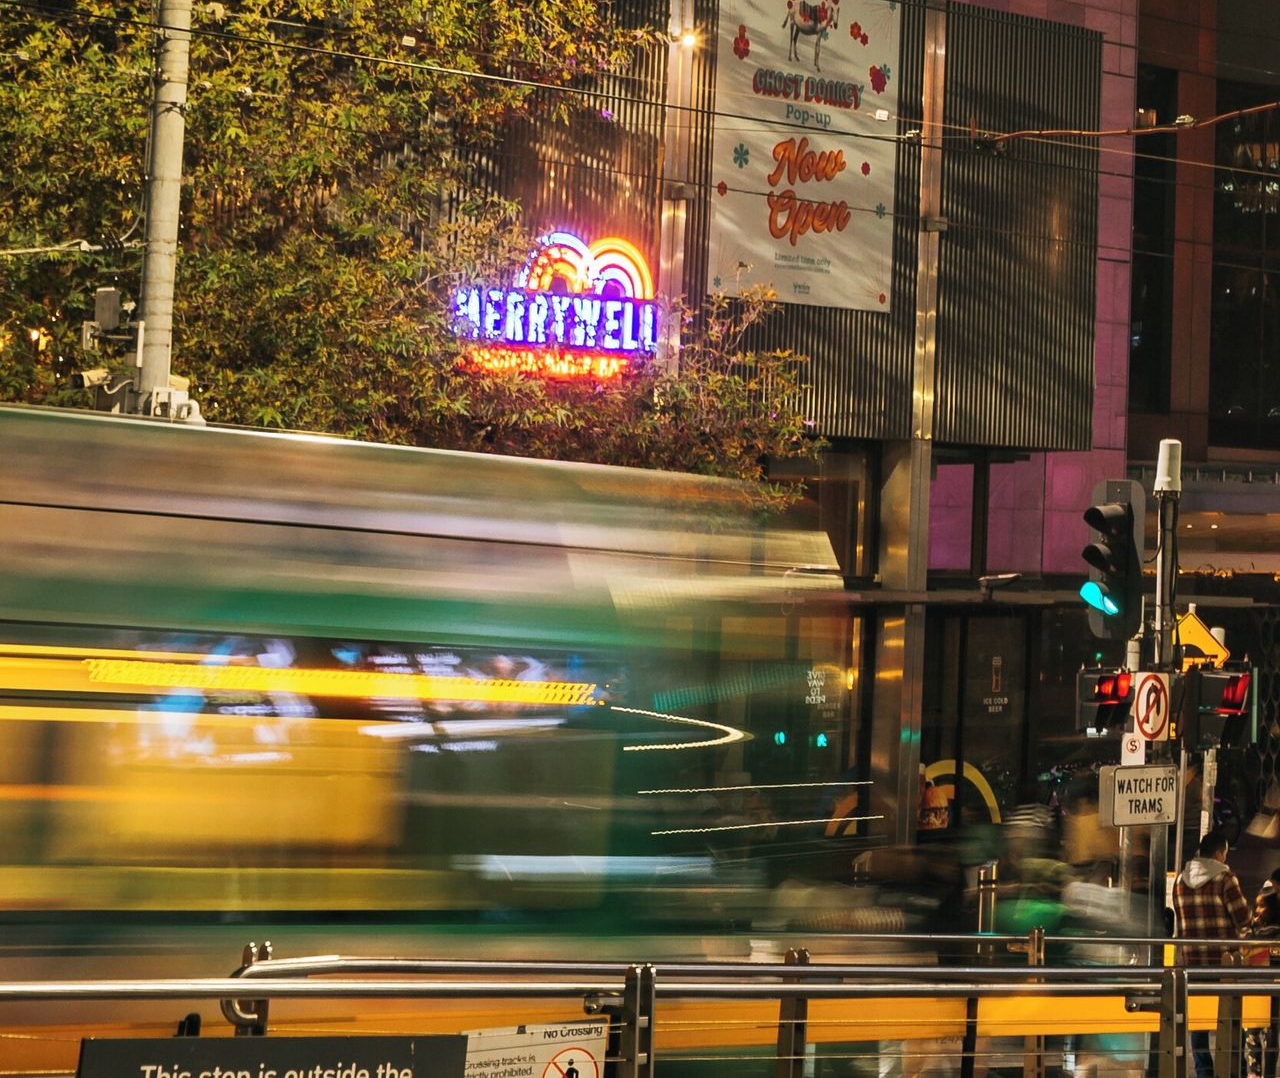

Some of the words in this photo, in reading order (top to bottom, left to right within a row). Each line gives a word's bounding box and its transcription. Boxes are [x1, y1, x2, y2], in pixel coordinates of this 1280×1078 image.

[753, 68, 804, 100] GHOST
[804, 76, 865, 110] DONKEY
[786, 104, 831, 128] Pop-up
[767, 136, 847, 187] Now
[767, 189, 851, 247] Open
[1117, 778, 1152, 794] WATCH
[1156, 776, 1174, 792] FOR
[1128, 798, 1163, 814] TRAMS
[543, 1029, 558, 1039] No
[560, 1023, 604, 1037] Crossing
